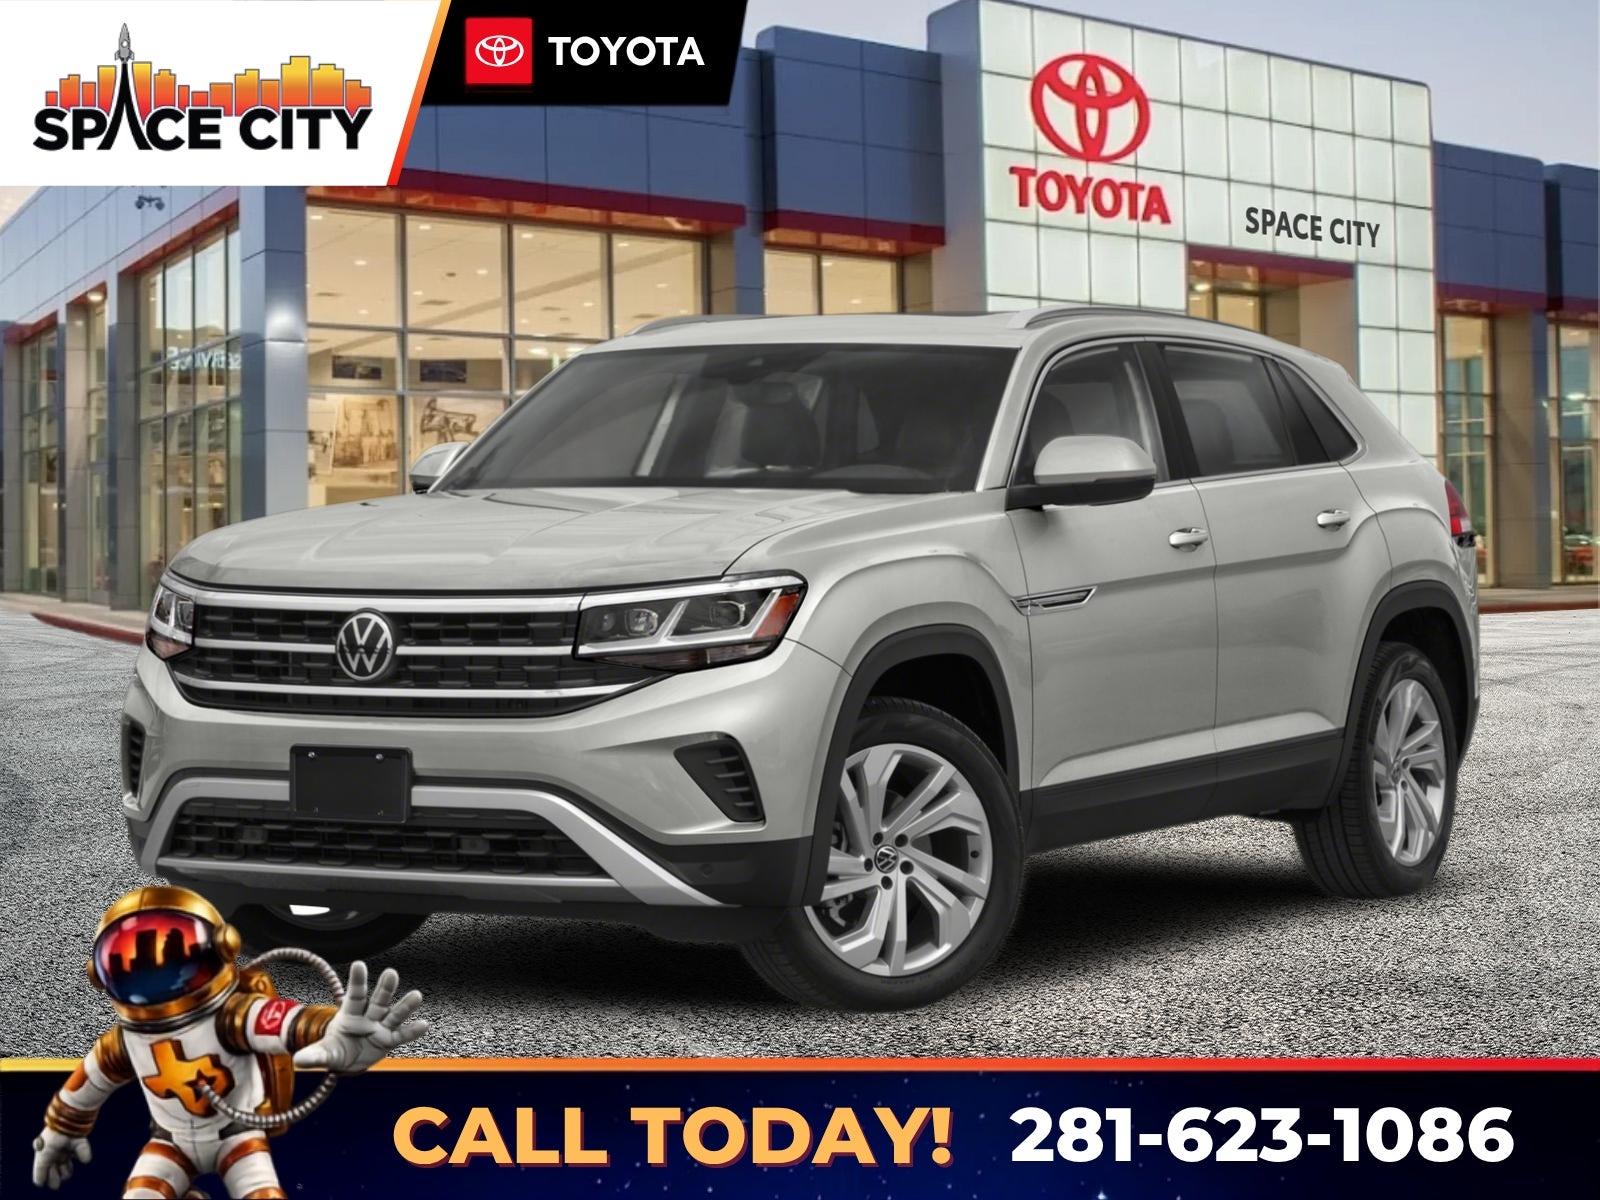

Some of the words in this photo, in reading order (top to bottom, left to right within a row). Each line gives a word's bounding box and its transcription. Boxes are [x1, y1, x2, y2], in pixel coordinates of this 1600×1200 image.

[1009, 166, 1171, 224] TOYOTA
[1245, 206, 1322, 242] SPACE
[1329, 218, 1380, 248] CITY
[336, 612, 393, 681] VW
